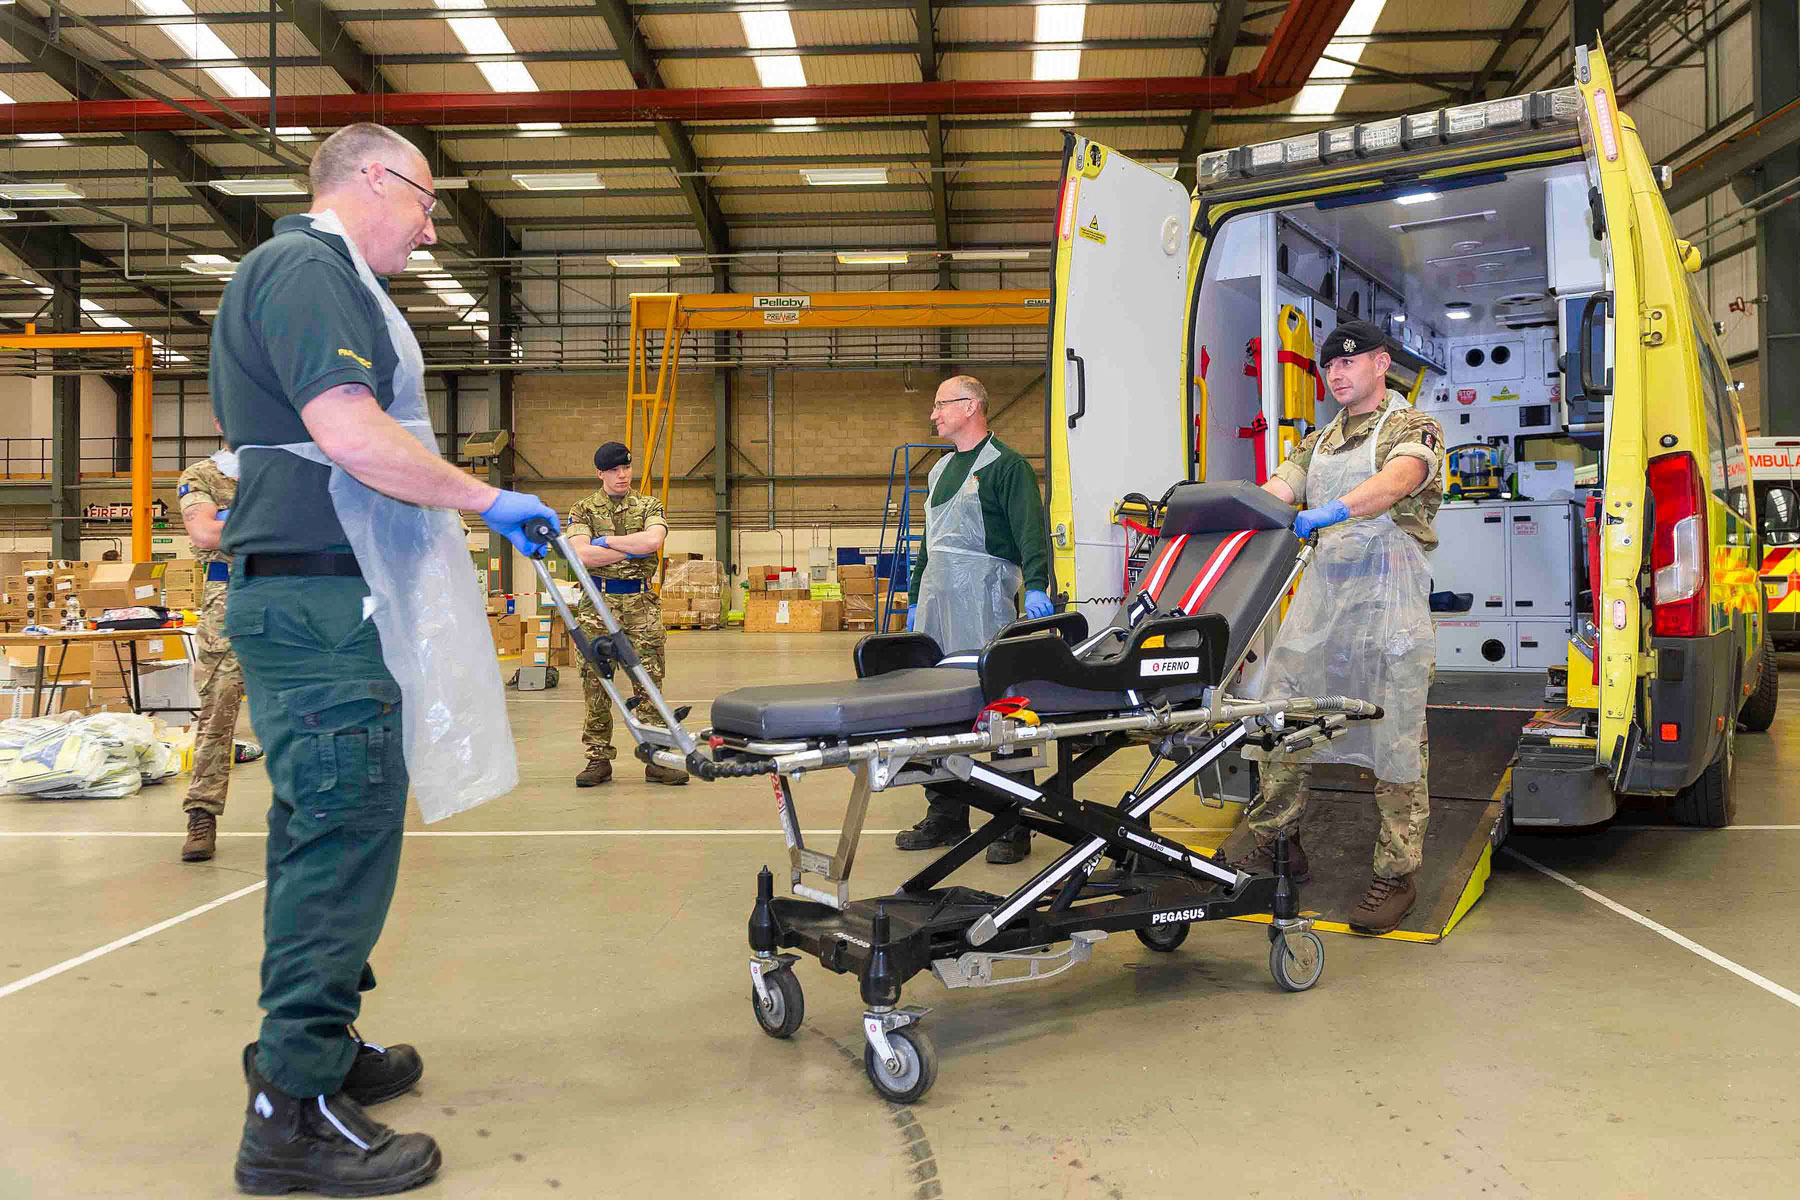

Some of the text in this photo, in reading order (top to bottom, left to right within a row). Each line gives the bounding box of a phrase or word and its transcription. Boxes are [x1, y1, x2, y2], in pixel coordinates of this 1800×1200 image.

[759, 298, 804, 307] Pelloby
[90, 508, 117, 518] FIRE
[1162, 661, 1190, 672] FERNO
[1149, 841, 1164, 852] FERNO
[1152, 908, 1205, 925] PEGASUS
